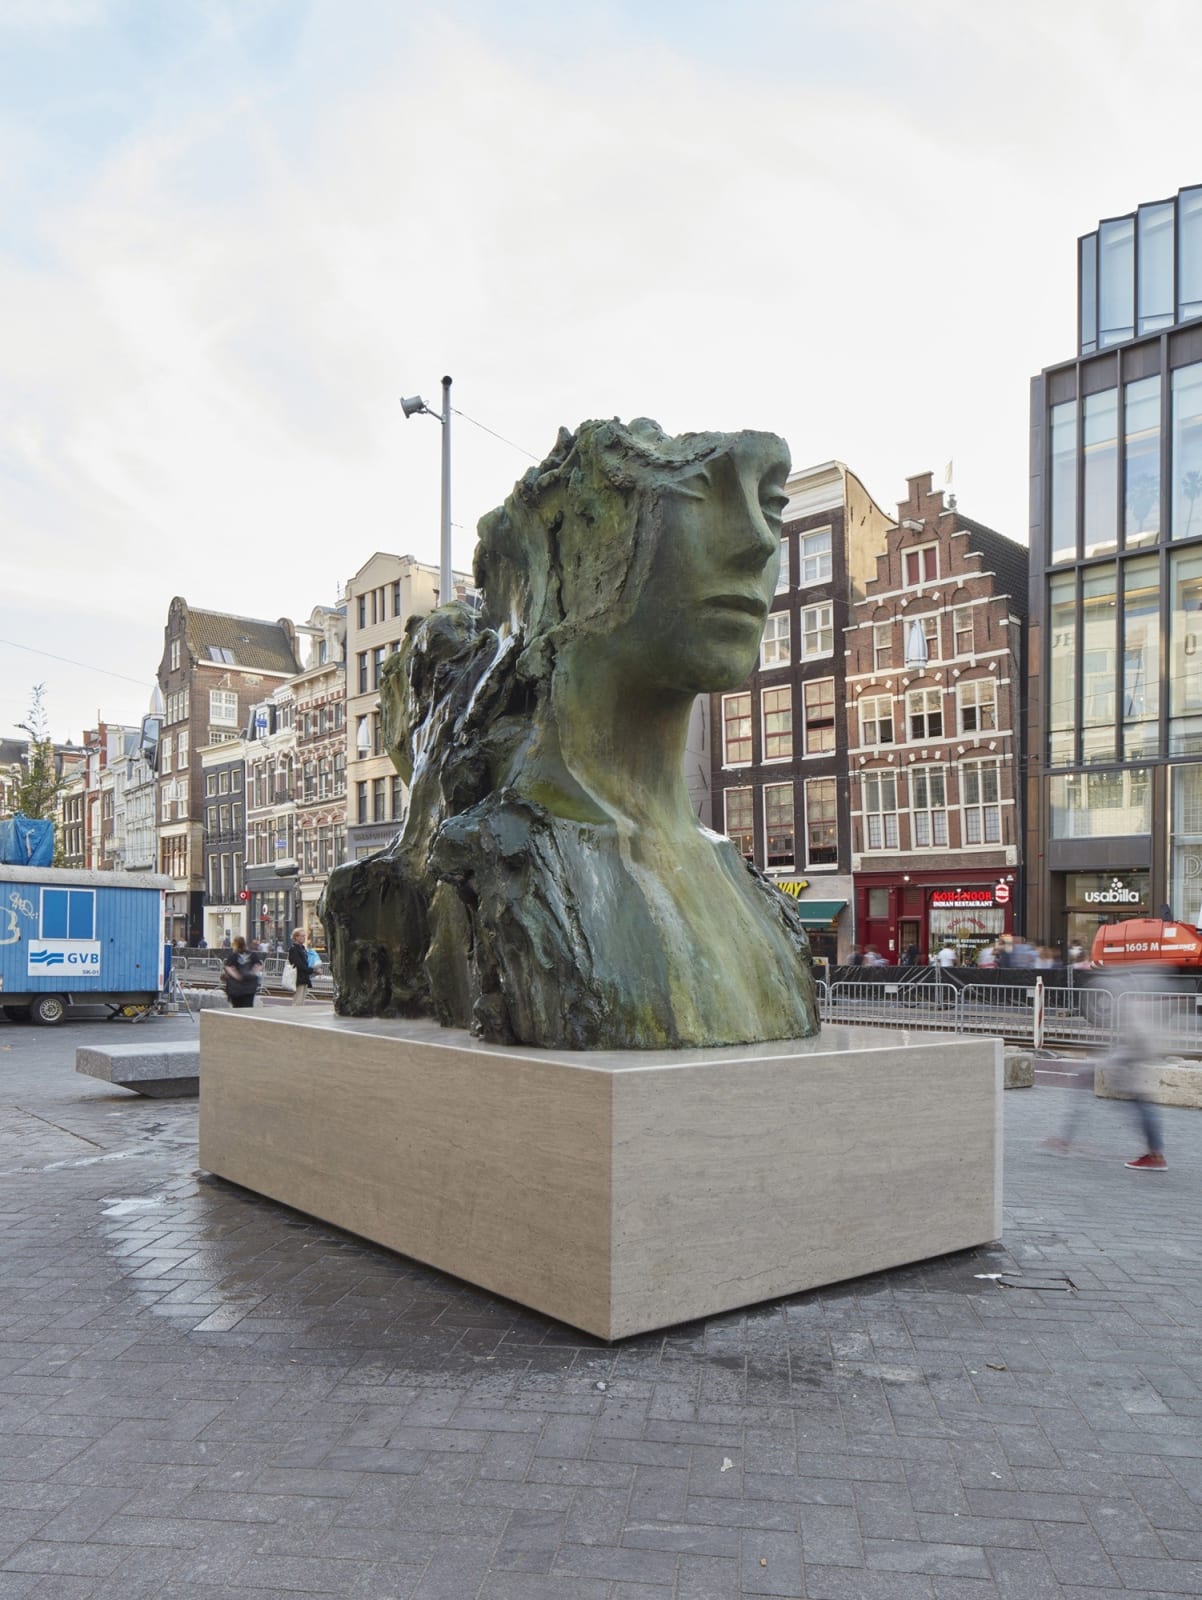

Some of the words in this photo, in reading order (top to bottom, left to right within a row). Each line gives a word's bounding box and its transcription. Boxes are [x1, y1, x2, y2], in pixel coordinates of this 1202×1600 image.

[1085, 889, 1139, 902] usabilla
[1125, 943, 1148, 952] 1605
[1150, 942, 1159, 951] M
[67, 953, 99, 964] GVB
